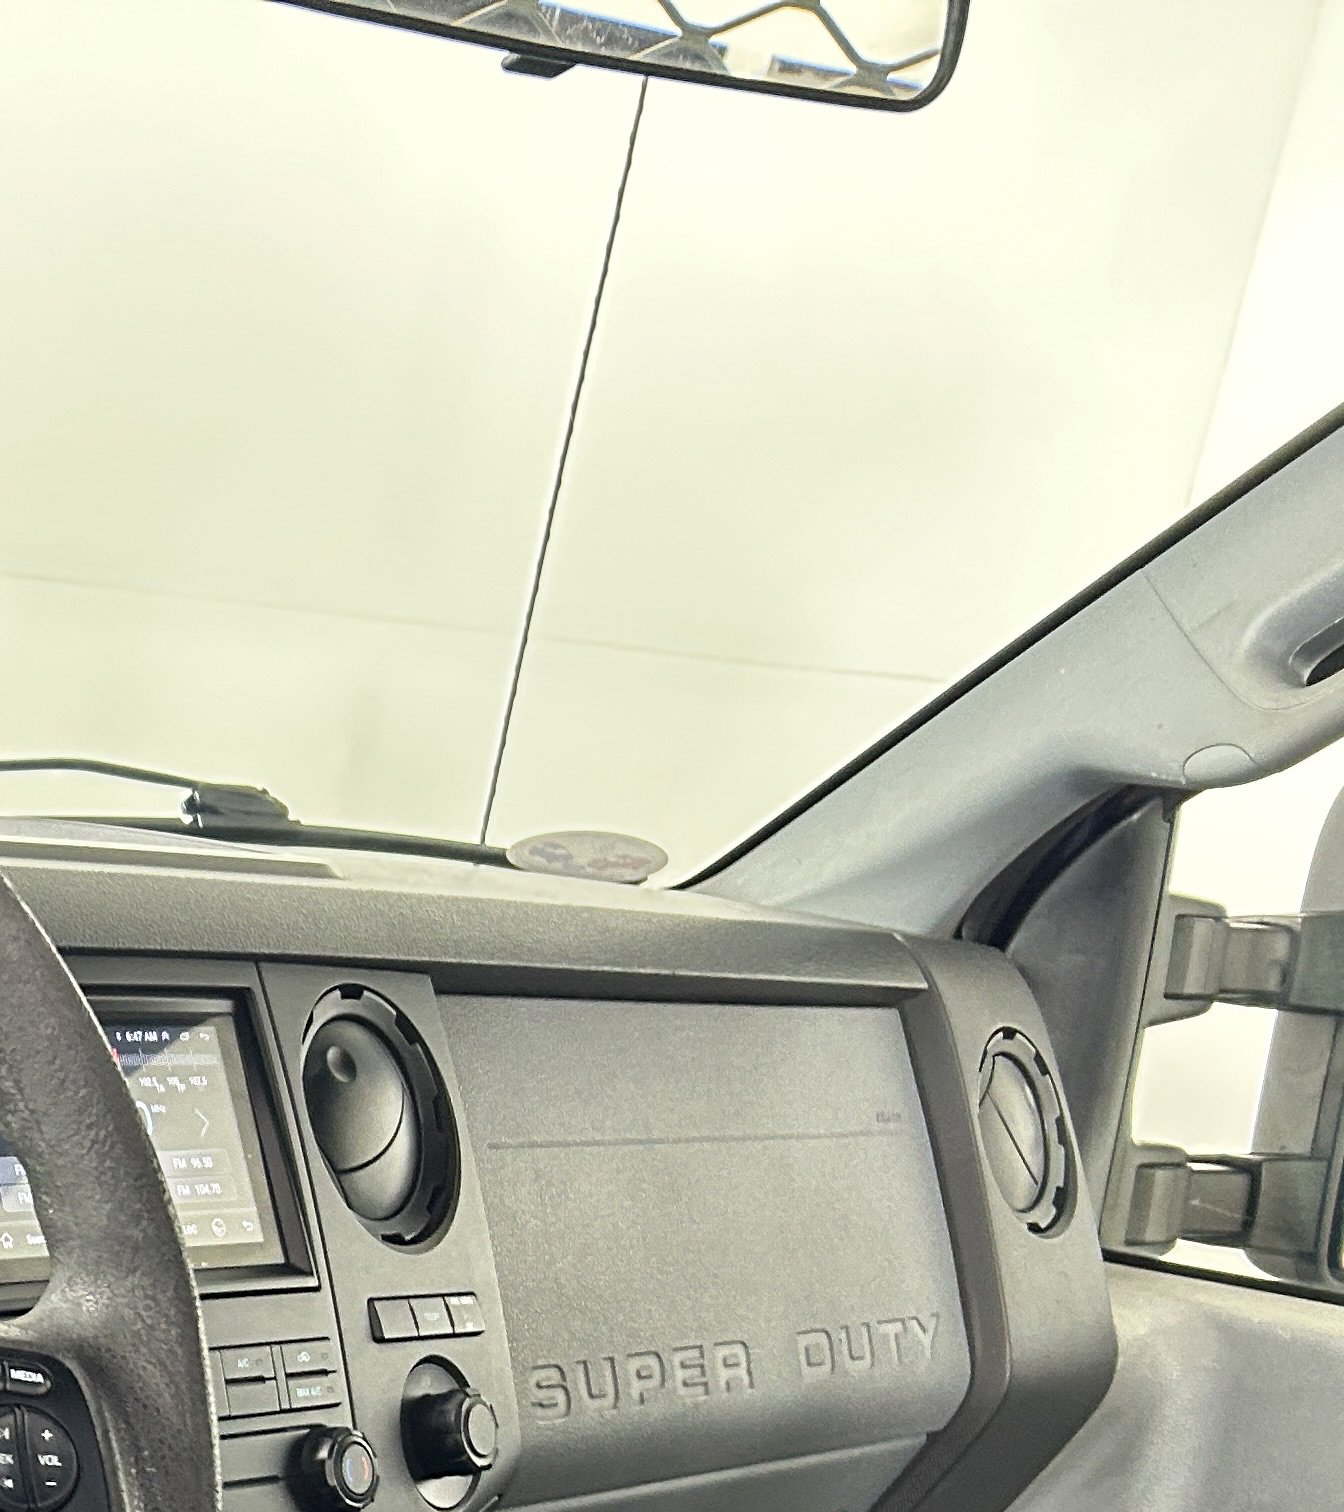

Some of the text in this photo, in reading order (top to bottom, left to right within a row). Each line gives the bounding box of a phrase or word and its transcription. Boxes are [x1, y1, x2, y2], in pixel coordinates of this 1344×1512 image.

[530, 1312, 940, 1424] SUPER DUTY
[10, 1369, 44, 1384] MEDIA
[37, 1454, 62, 1466] VOL
